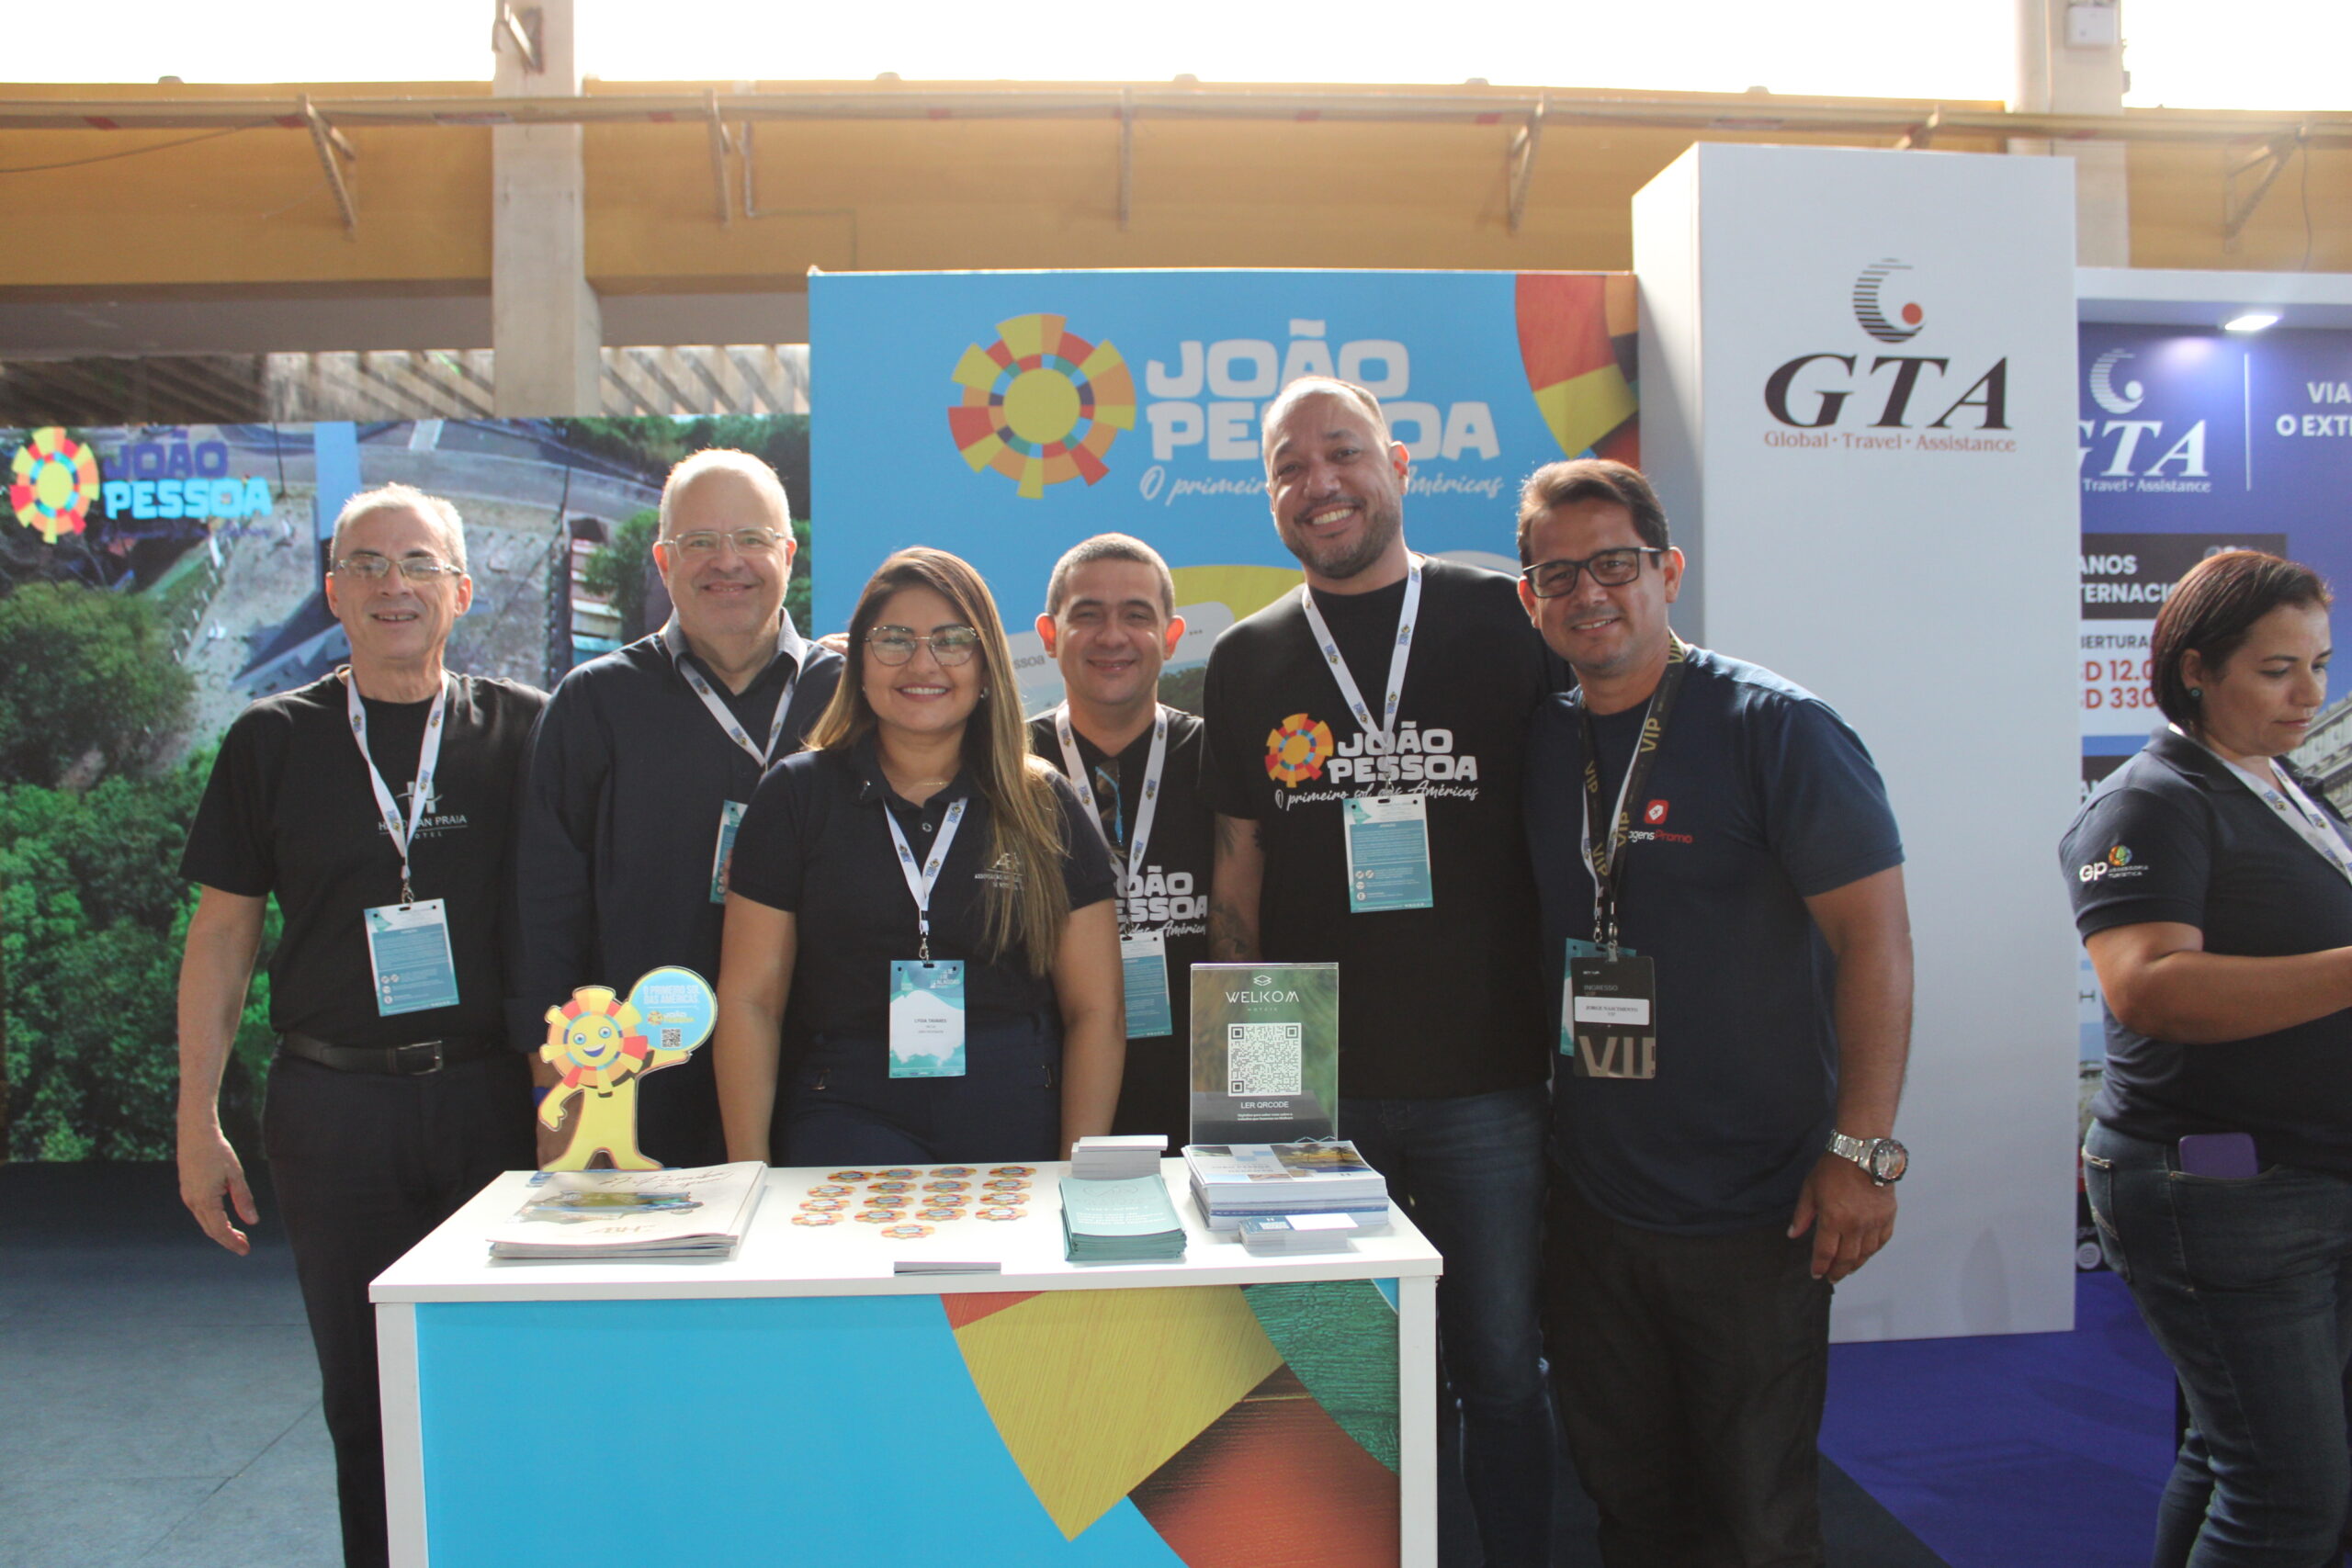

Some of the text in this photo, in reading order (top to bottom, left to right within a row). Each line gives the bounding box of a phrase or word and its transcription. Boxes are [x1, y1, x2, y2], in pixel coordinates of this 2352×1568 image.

[1146, 318, 1409, 399] JOÃO
[1763, 353, 2012, 430] GTA
[2306, 381, 2352, 404] VIA
[1146, 401, 1500, 461] PEOA
[2276, 414, 2352, 437] O EXT
[103, 430, 229, 479] JOÃO
[1764, 431, 2017, 453] Global Travel Assistance
[2078, 419, 2209, 477] TA
[102, 477, 273, 520] PESSOA
[1139, 465, 1165, 501] O
[1164, 477, 1272, 506] primeir
[2083, 478, 2211, 493] Travel Assistance
[2080, 582, 2179, 604] ERNACI
[2081, 635, 2149, 649] ERTURA
[1012, 655, 1046, 670] ssoa
[1338, 720, 1453, 757] JOÃO
[1640, 717, 1661, 752] VIP
[1327, 754, 1478, 784] PESSOA
[1585, 760, 1599, 793] VIP
[1286, 790, 1349, 811] primeiro
[414, 830, 443, 840] OTEL
[435, 815, 468, 826] PRAIA
[1617, 811, 1630, 847] VIP
[1592, 842, 1609, 876] VIP
[1114, 865, 1193, 898] OÃO
[1114, 895, 1208, 924] ESSOA
[1226, 990, 1300, 1004] WELKOM
[1256, 1100, 1290, 1109] QRCODE
